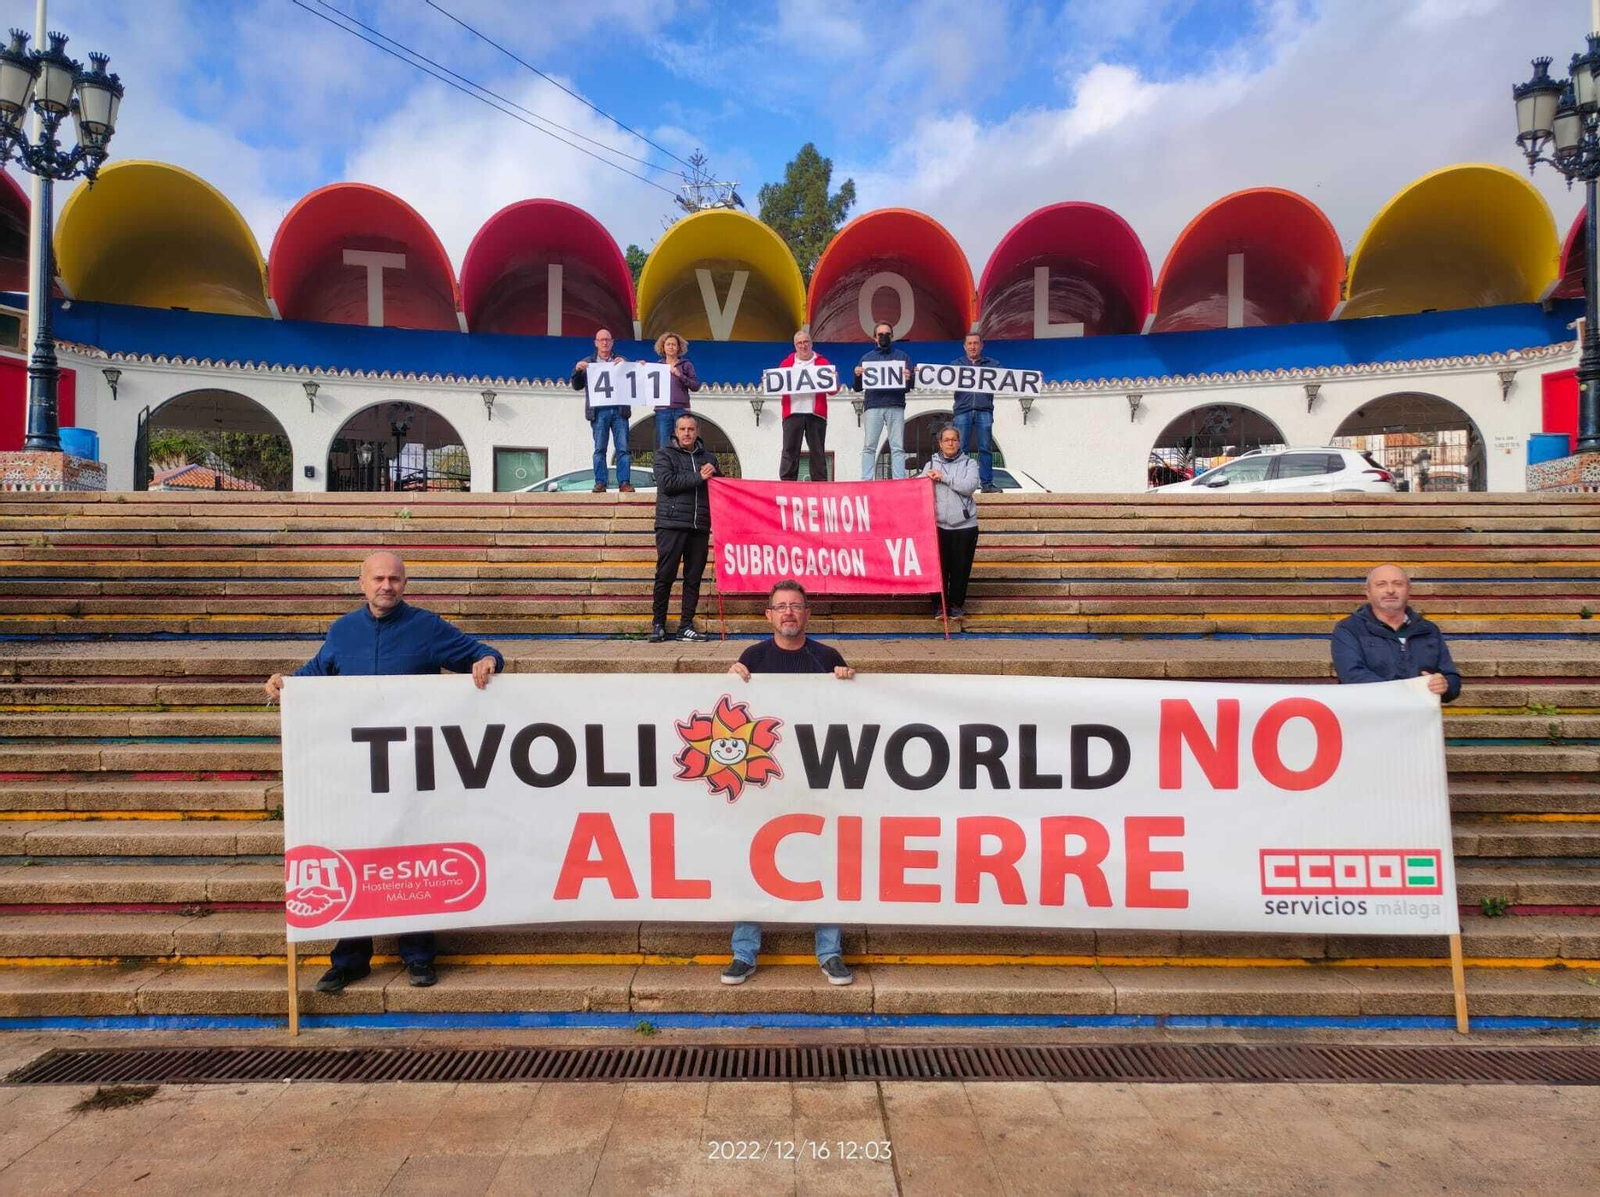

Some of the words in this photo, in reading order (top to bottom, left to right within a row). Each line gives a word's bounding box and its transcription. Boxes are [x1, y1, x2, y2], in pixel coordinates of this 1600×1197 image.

[342, 248, 1245, 341] TIVOLI
[594, 370, 660, 399] 411
[766, 367, 834, 393] DIAS
[863, 366, 903, 386] SIN
[918, 365, 1040, 393] COBRAR
[775, 495, 870, 532] TREMON
[724, 543, 866, 577] SUBROGACION
[885, 537, 922, 576] YA
[351, 722, 657, 793] TIVOLI
[794, 722, 1132, 791] WORLD
[1158, 697, 1343, 791] NO
[362, 858, 458, 881] FeSMC
[552, 812, 712, 901] AL
[748, 812, 1190, 909] CIERRE
[1263, 855, 1403, 888] CCOO
[424, 878, 464, 888] Turismo
[1264, 896, 1368, 916] servicios
[1375, 900, 1442, 919] málaga
